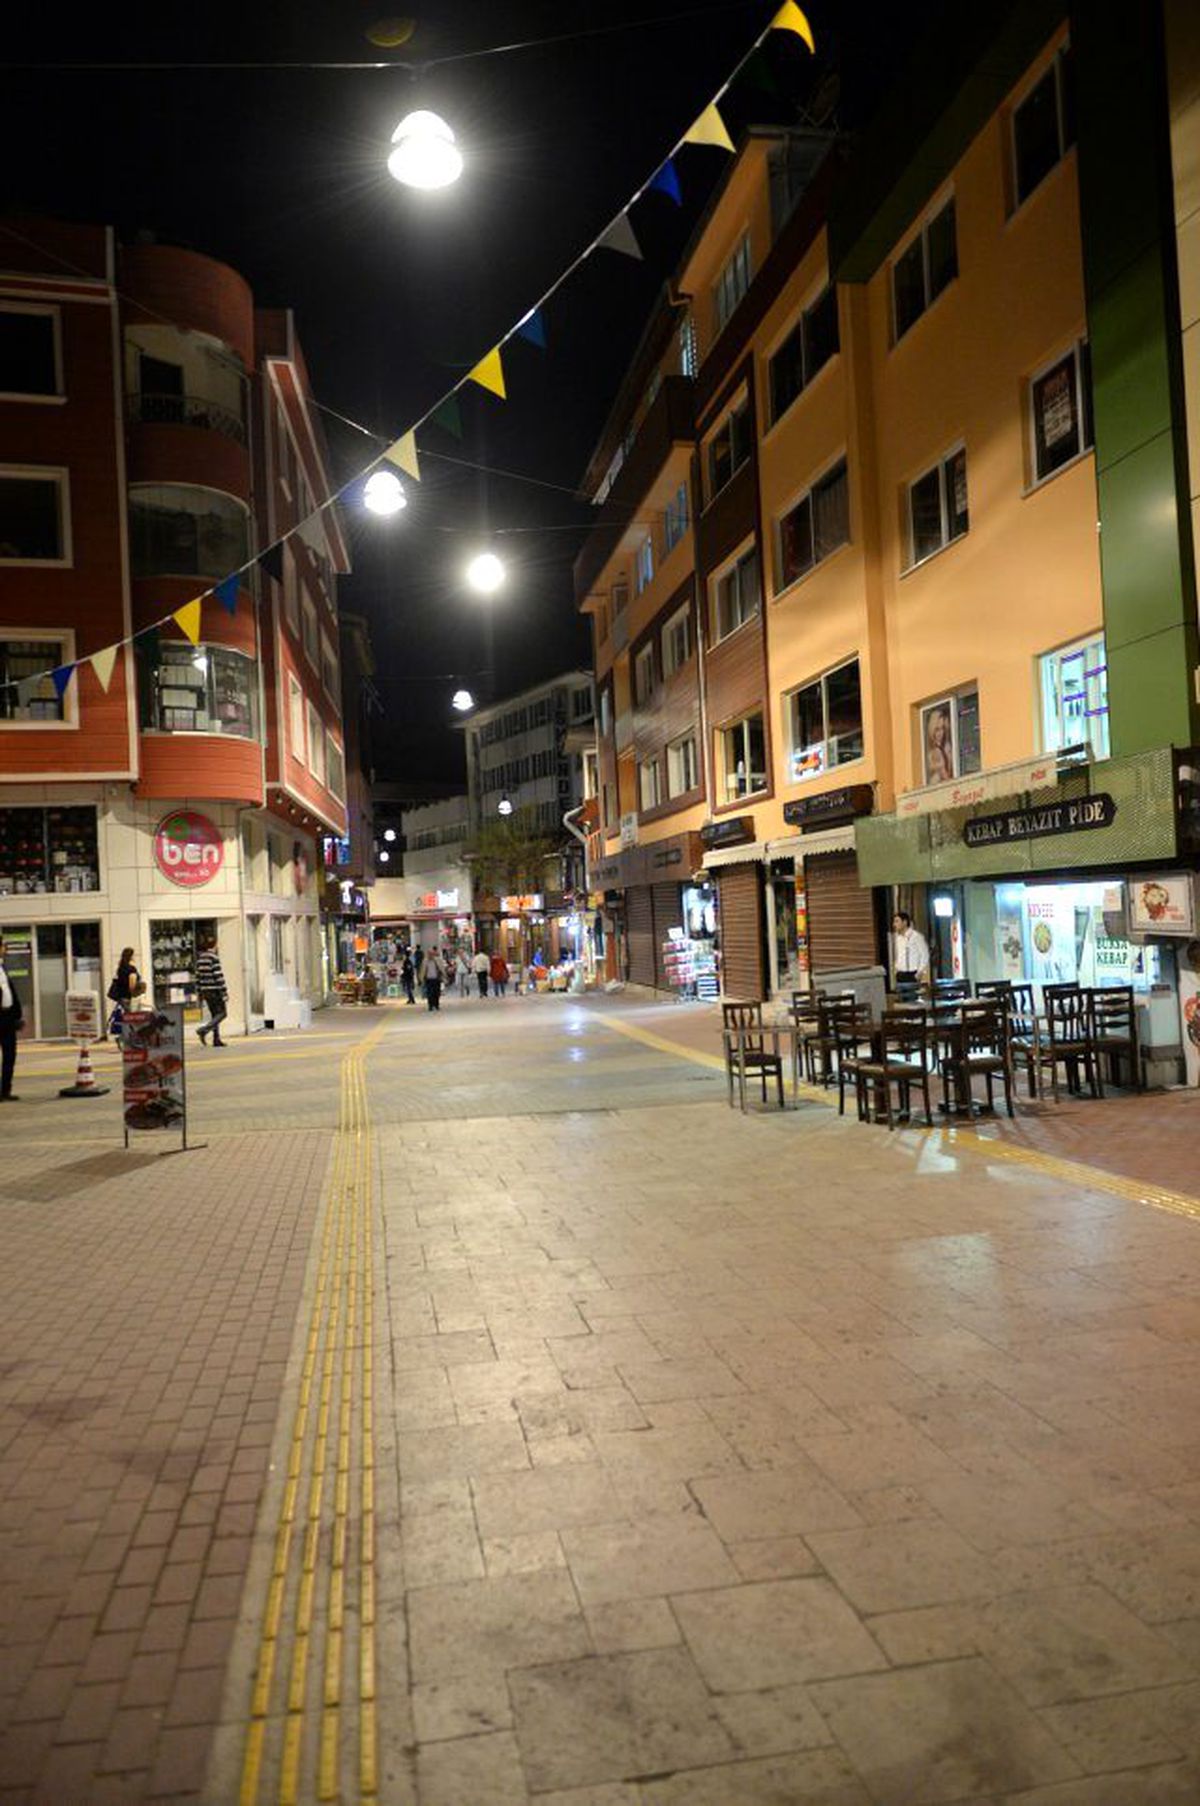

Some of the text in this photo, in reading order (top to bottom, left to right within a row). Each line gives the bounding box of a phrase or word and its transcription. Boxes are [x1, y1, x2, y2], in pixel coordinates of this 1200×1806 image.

[967, 801, 1105, 842] KEBAP BEYAZIT PİDE
[161, 832, 219, 866] ben
[1096, 951, 1128, 965] KEBAP
